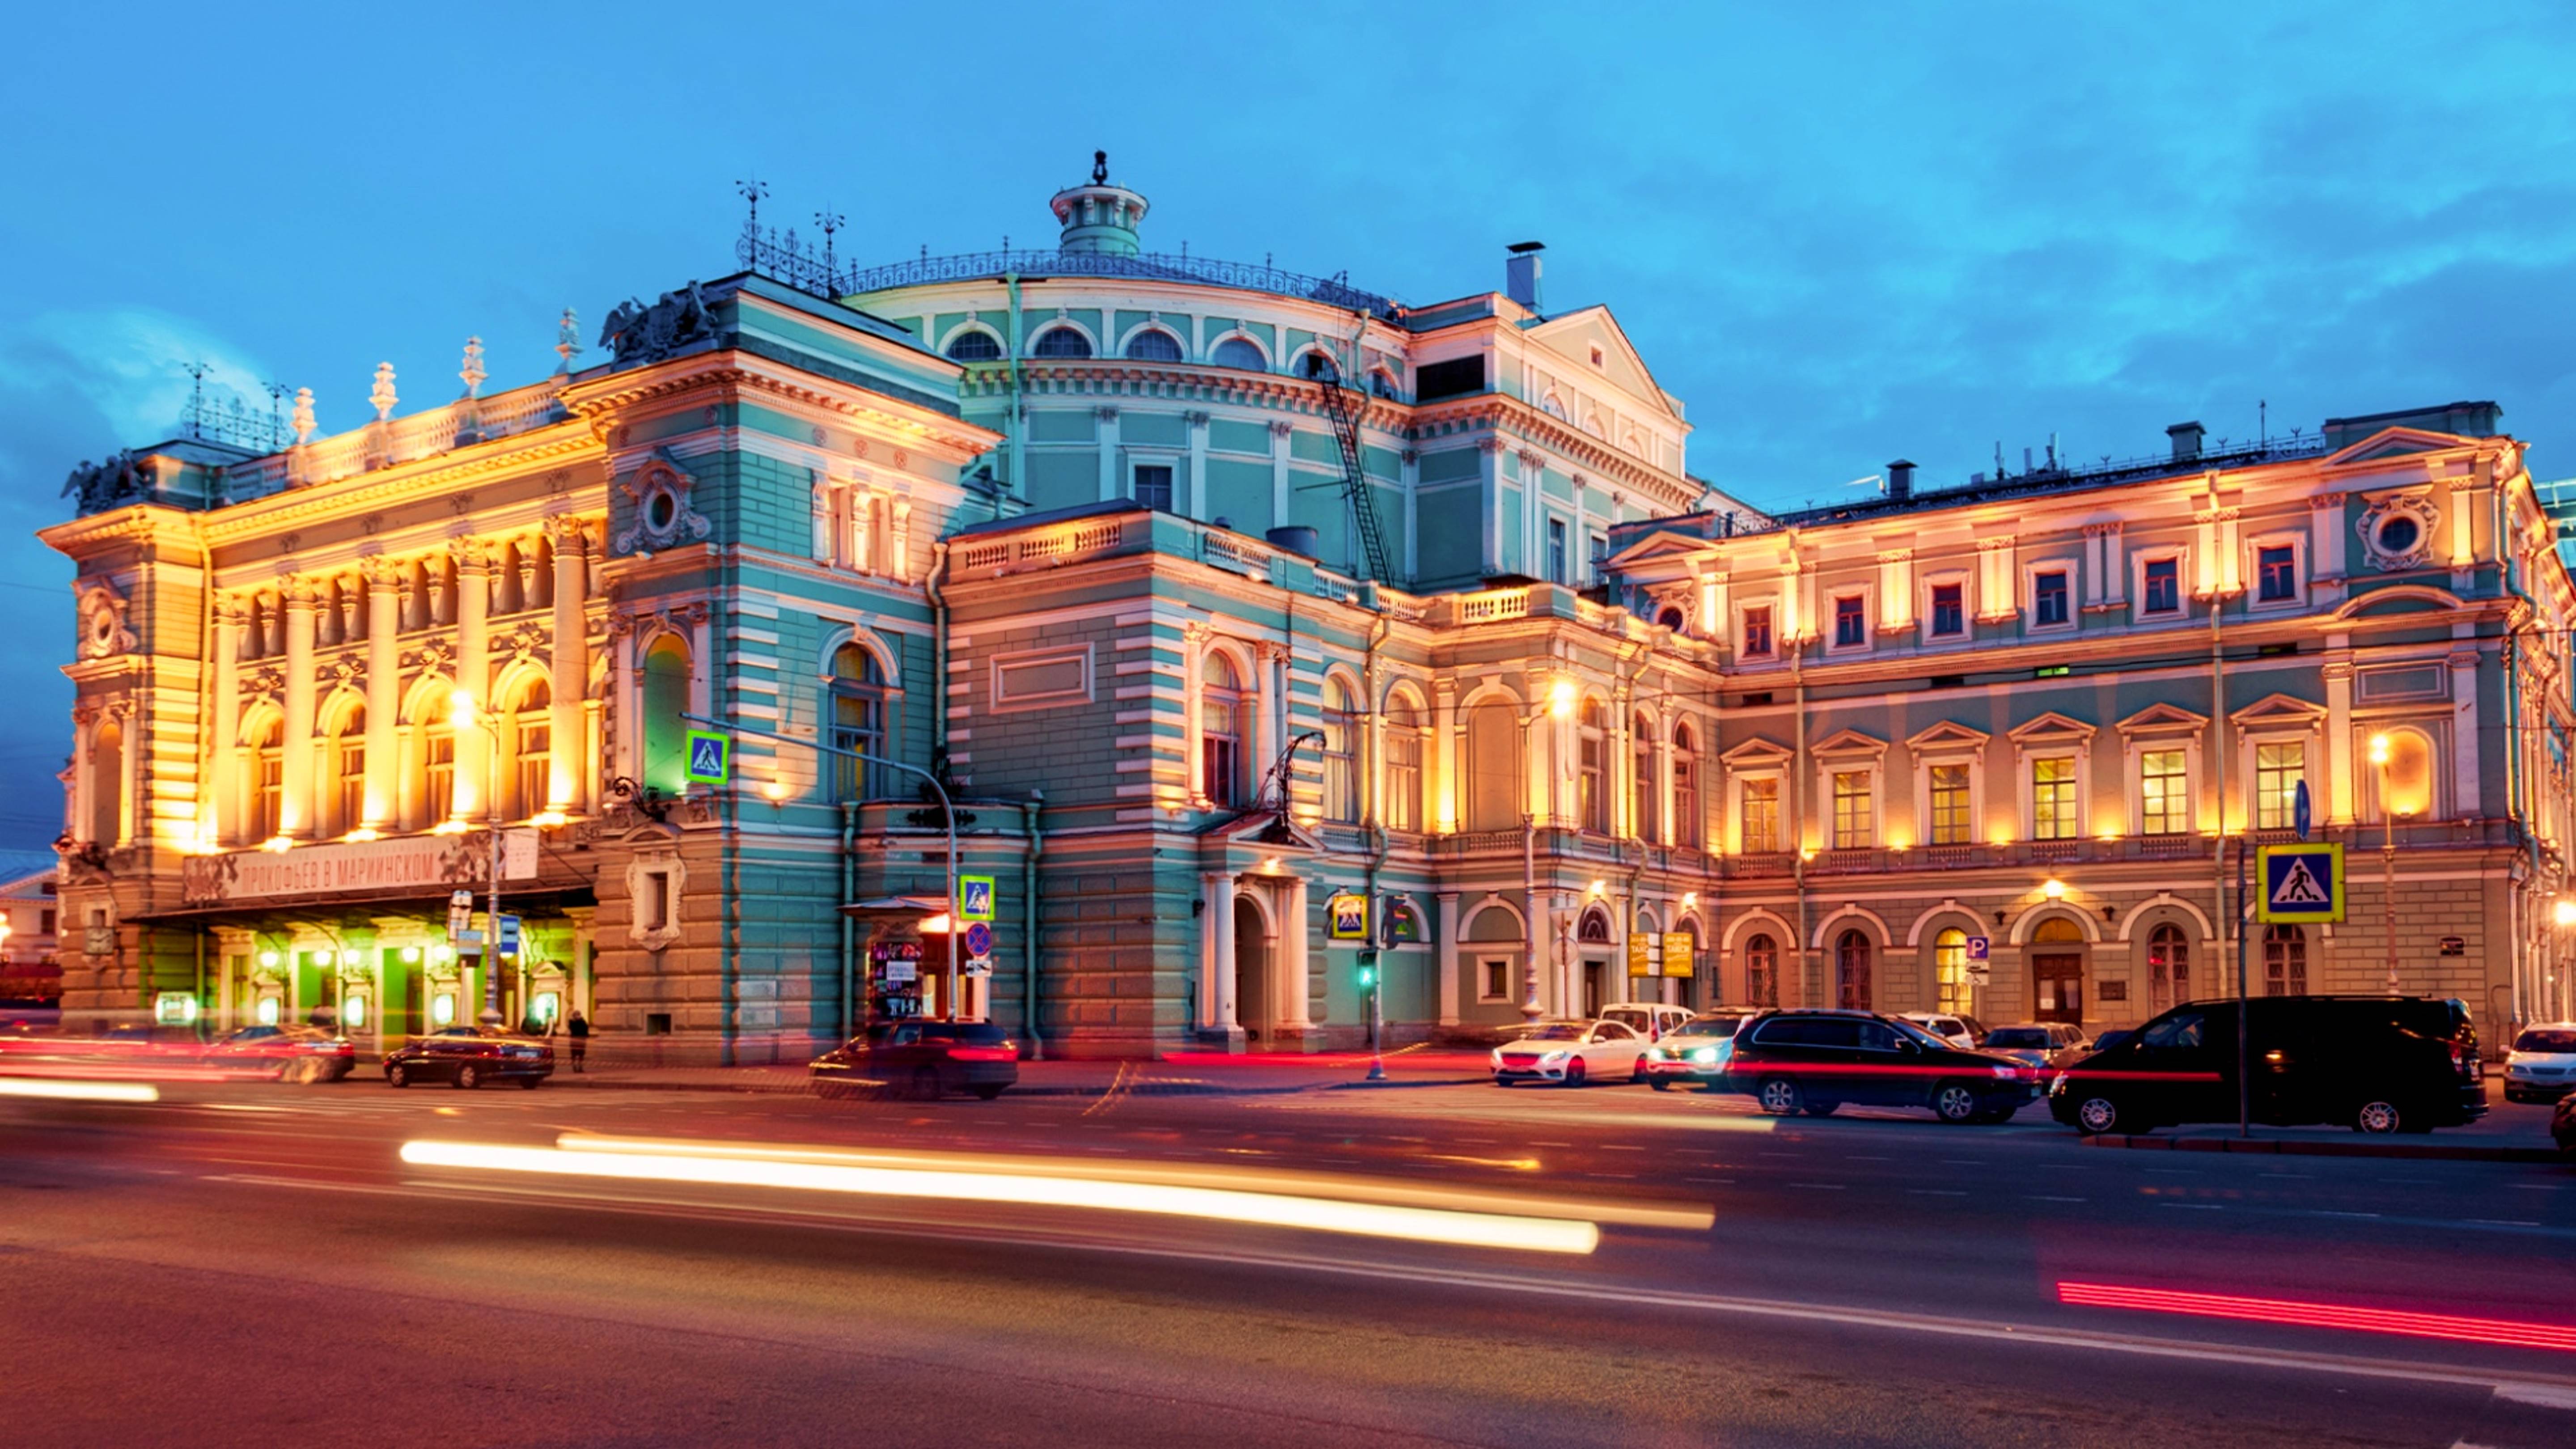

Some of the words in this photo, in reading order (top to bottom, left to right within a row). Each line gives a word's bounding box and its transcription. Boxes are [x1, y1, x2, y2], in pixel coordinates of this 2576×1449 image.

[242, 861, 318, 893] ПРОКОФЬЕВ
[324, 860, 331, 887] В
[337, 853, 434, 886] МАРИИНСКОМ
